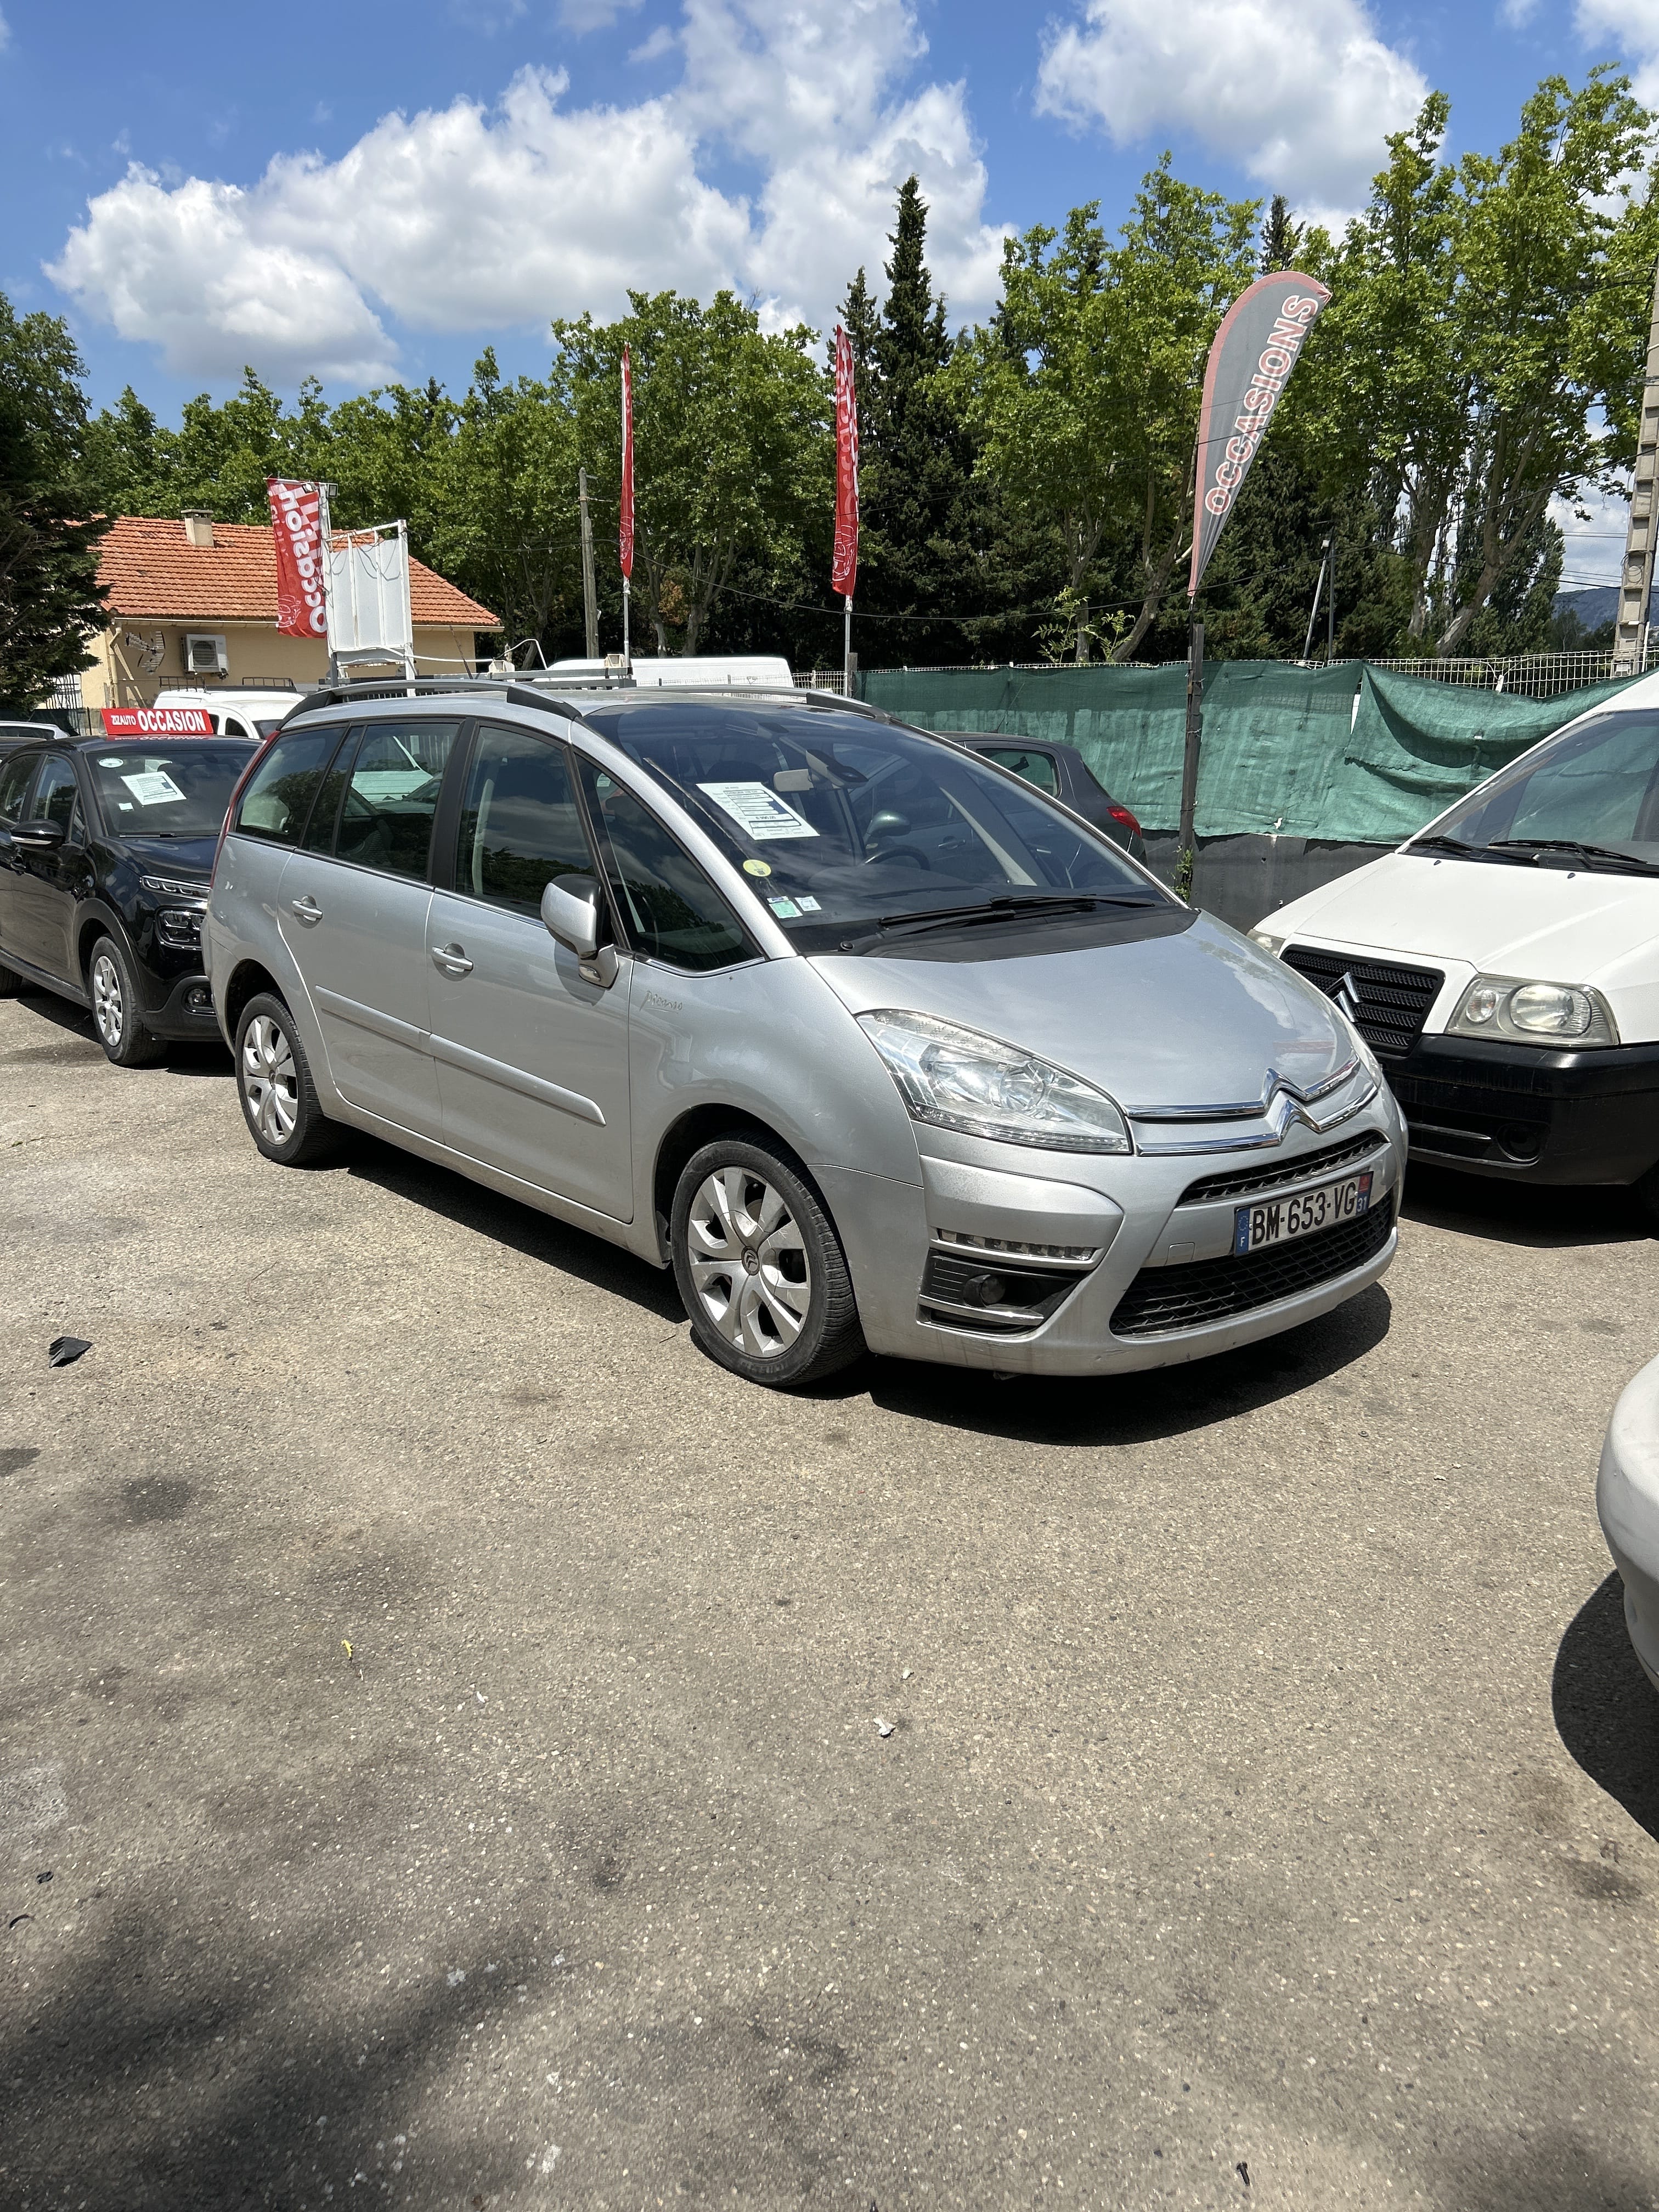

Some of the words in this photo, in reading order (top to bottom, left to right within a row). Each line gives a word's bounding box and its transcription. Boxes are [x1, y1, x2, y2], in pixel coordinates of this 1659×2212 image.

[1205, 295, 1318, 515] OCCASIONS
[110, 715, 137, 726] ZIZAUTO
[138, 710, 206, 731] OCCASION
[1240, 1237, 1245, 1247] F
[1252, 1182, 1356, 1245] BM-653-VG
[1357, 1196, 1367, 1212] 31
